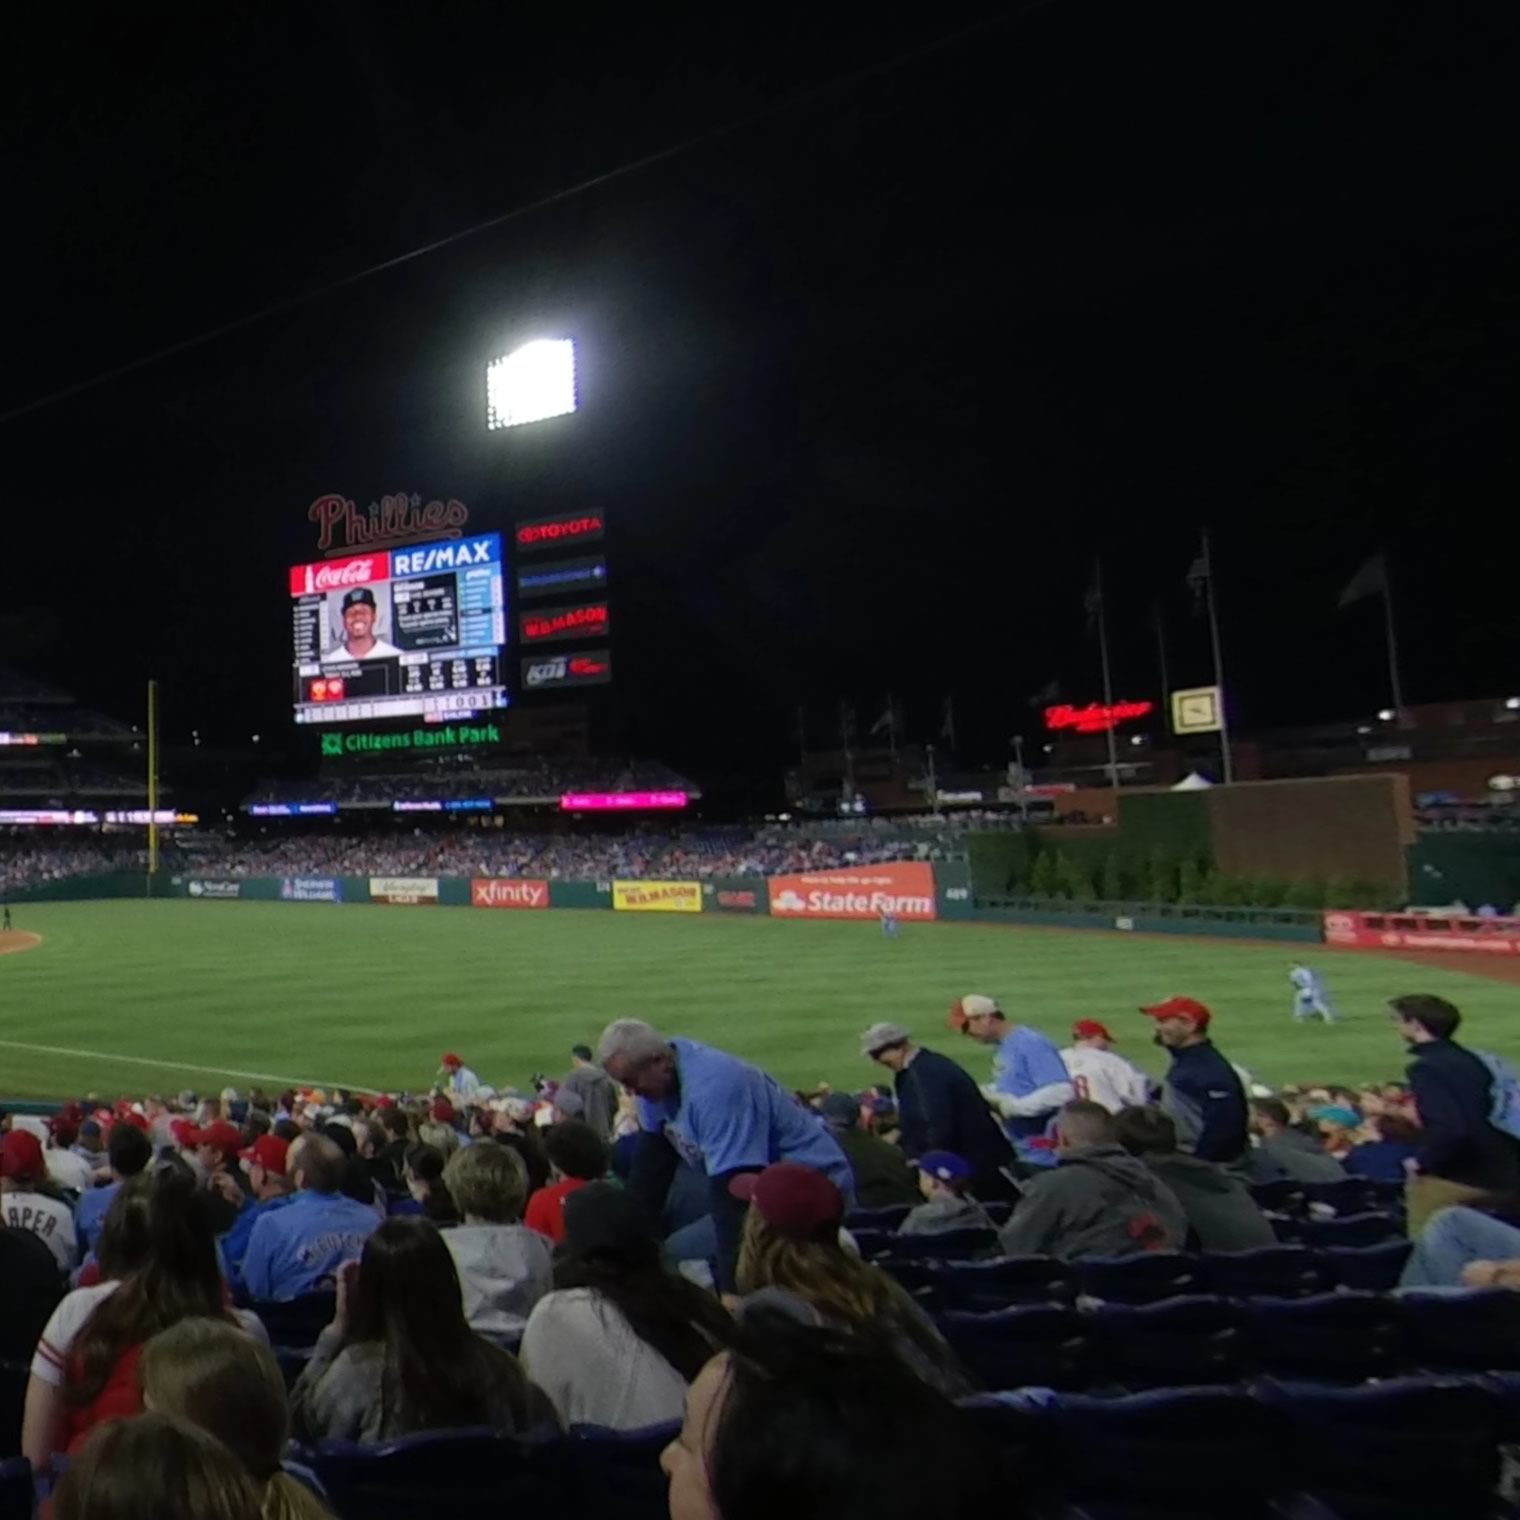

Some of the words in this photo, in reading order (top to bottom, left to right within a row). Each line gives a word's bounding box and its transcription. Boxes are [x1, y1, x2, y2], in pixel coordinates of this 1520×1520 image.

[309, 492, 467, 557] Phillies
[539, 518, 602, 541] TOYOTA
[394, 541, 492, 575] RE/MAX
[345, 731, 411, 752] Citizens
[413, 727, 456, 747] Bank
[459, 725, 500, 744] Park
[476, 881, 545, 906] xfinity
[807, 891, 868, 912] State
[870, 891, 930, 913] Farm
